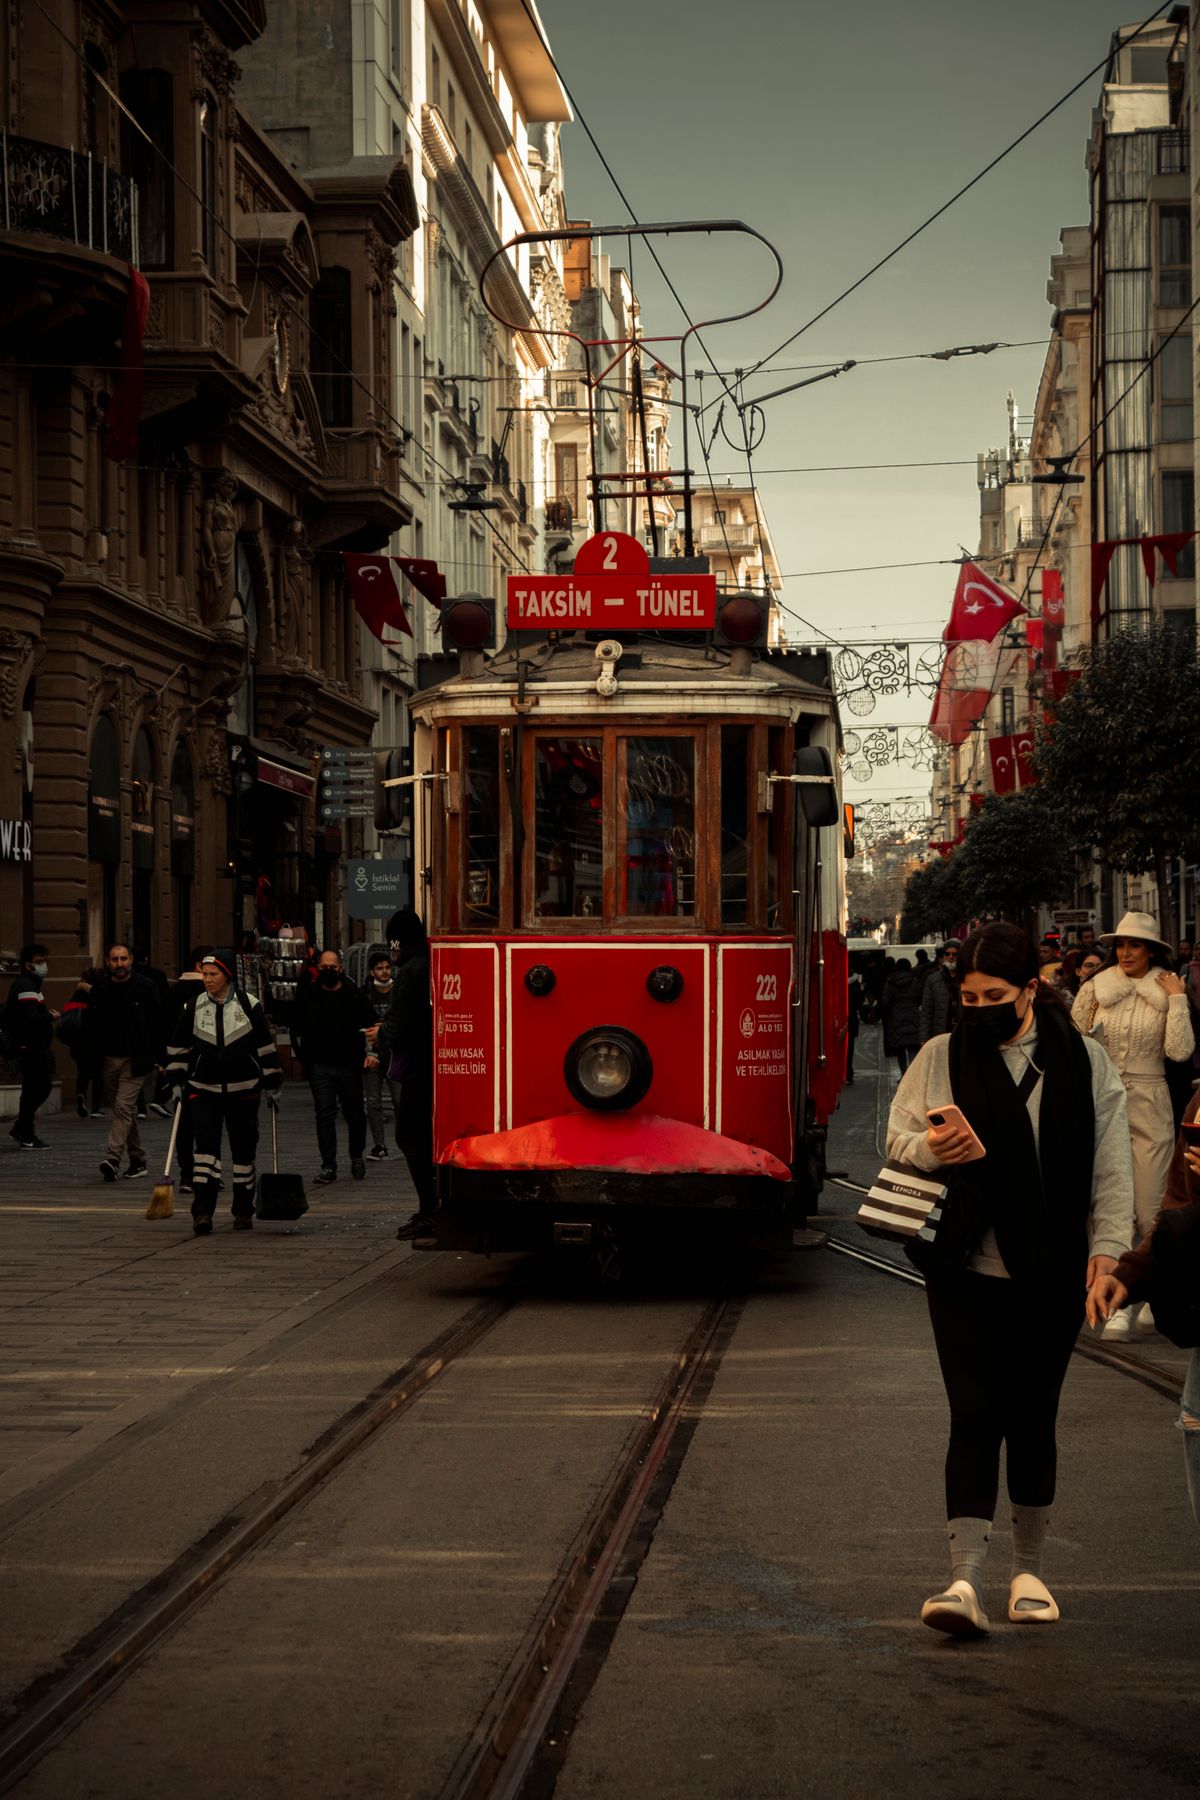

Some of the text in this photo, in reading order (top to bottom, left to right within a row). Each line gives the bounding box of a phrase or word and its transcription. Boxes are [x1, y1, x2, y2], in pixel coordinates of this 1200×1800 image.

[602, 536, 618, 570] 2
[514, 582, 592, 617] TAKSİM
[636, 582, 705, 617] TÜNEL
[371, 882, 397, 892] Senin
[443, 974, 461, 1000] 223
[756, 974, 777, 1001] 223
[446, 1023, 457, 1033] ALO
[459, 1023, 473, 1033] 153
[758, 1023, 772, 1033] ALO
[460, 1048, 484, 1058] YASAK
[737, 1050, 770, 1060] ASILMAK
[736, 1066, 747, 1077] VE
[892, 1185, 922, 1197] SEPHORA
